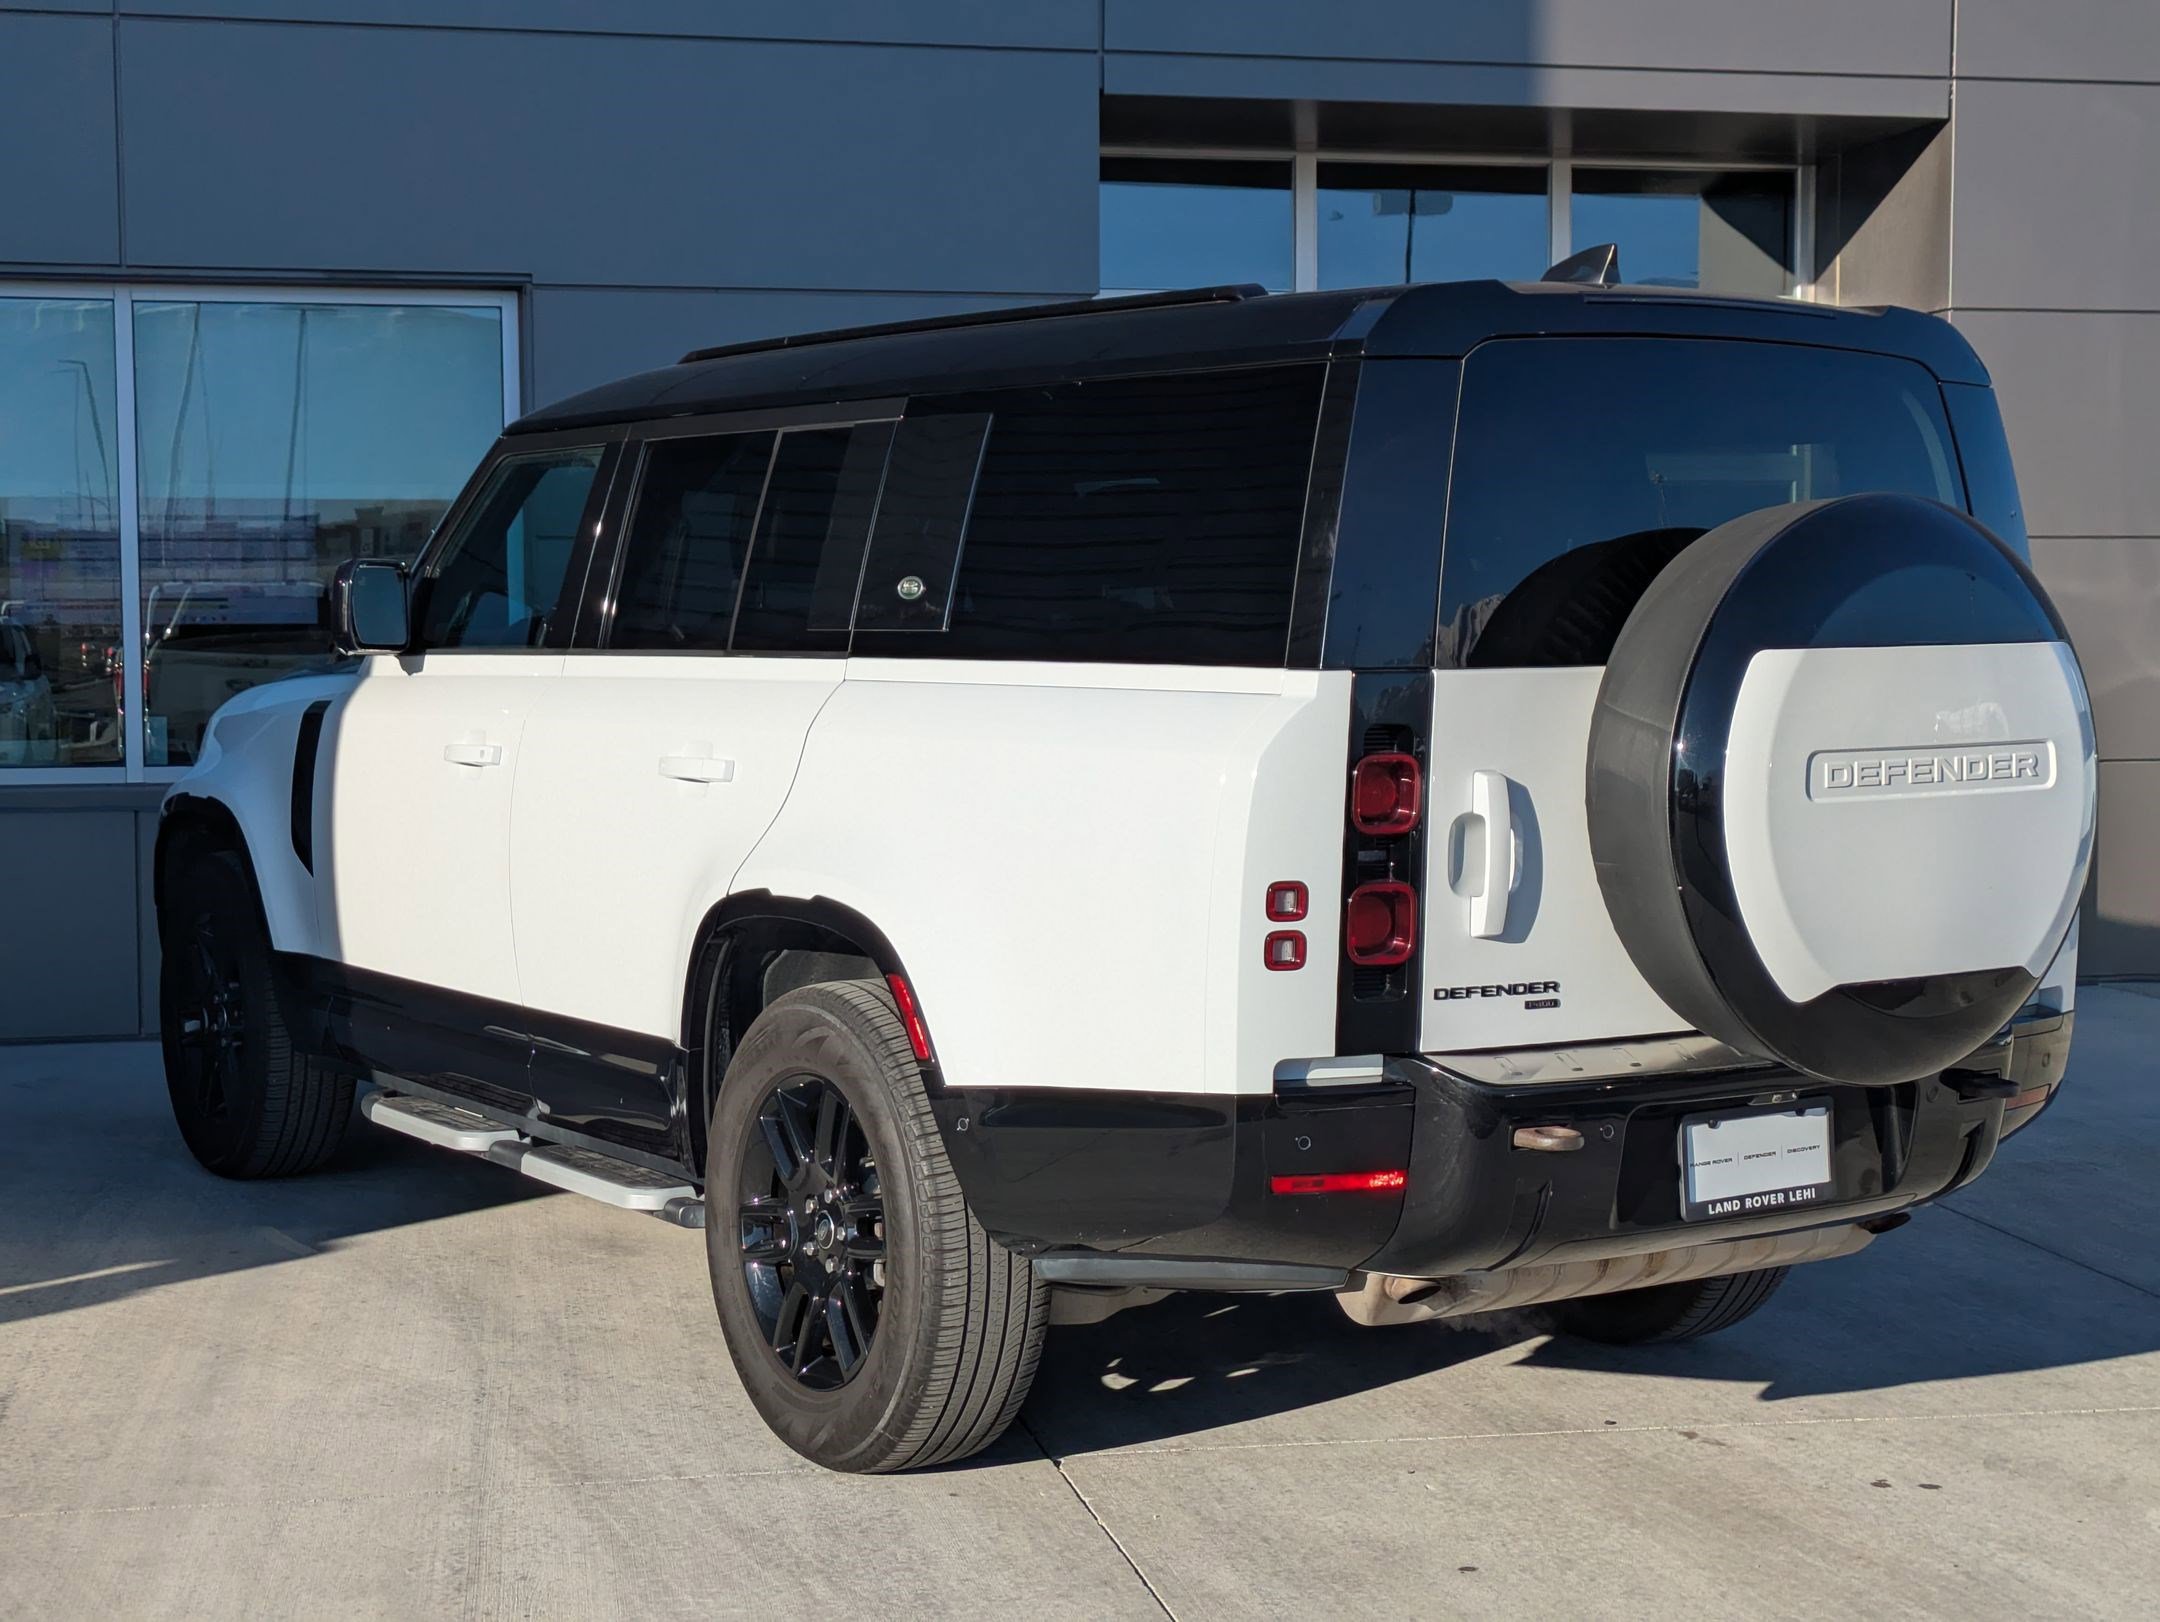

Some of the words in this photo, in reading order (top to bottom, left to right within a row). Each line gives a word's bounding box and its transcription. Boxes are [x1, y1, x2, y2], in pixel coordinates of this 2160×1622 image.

[1824, 752, 2039, 789] DEFENDER
[1434, 981, 1560, 1000] DEFENDER
[1690, 1160, 1711, 1168] RANGE
[1743, 1151, 1776, 1160] DEFENDER
[1787, 1145, 1820, 1154] DISCOVERY
[1708, 1200, 1741, 1215] LAND
[1745, 1192, 1784, 1209] ROVER
[1789, 1187, 1816, 1203] LEHI
